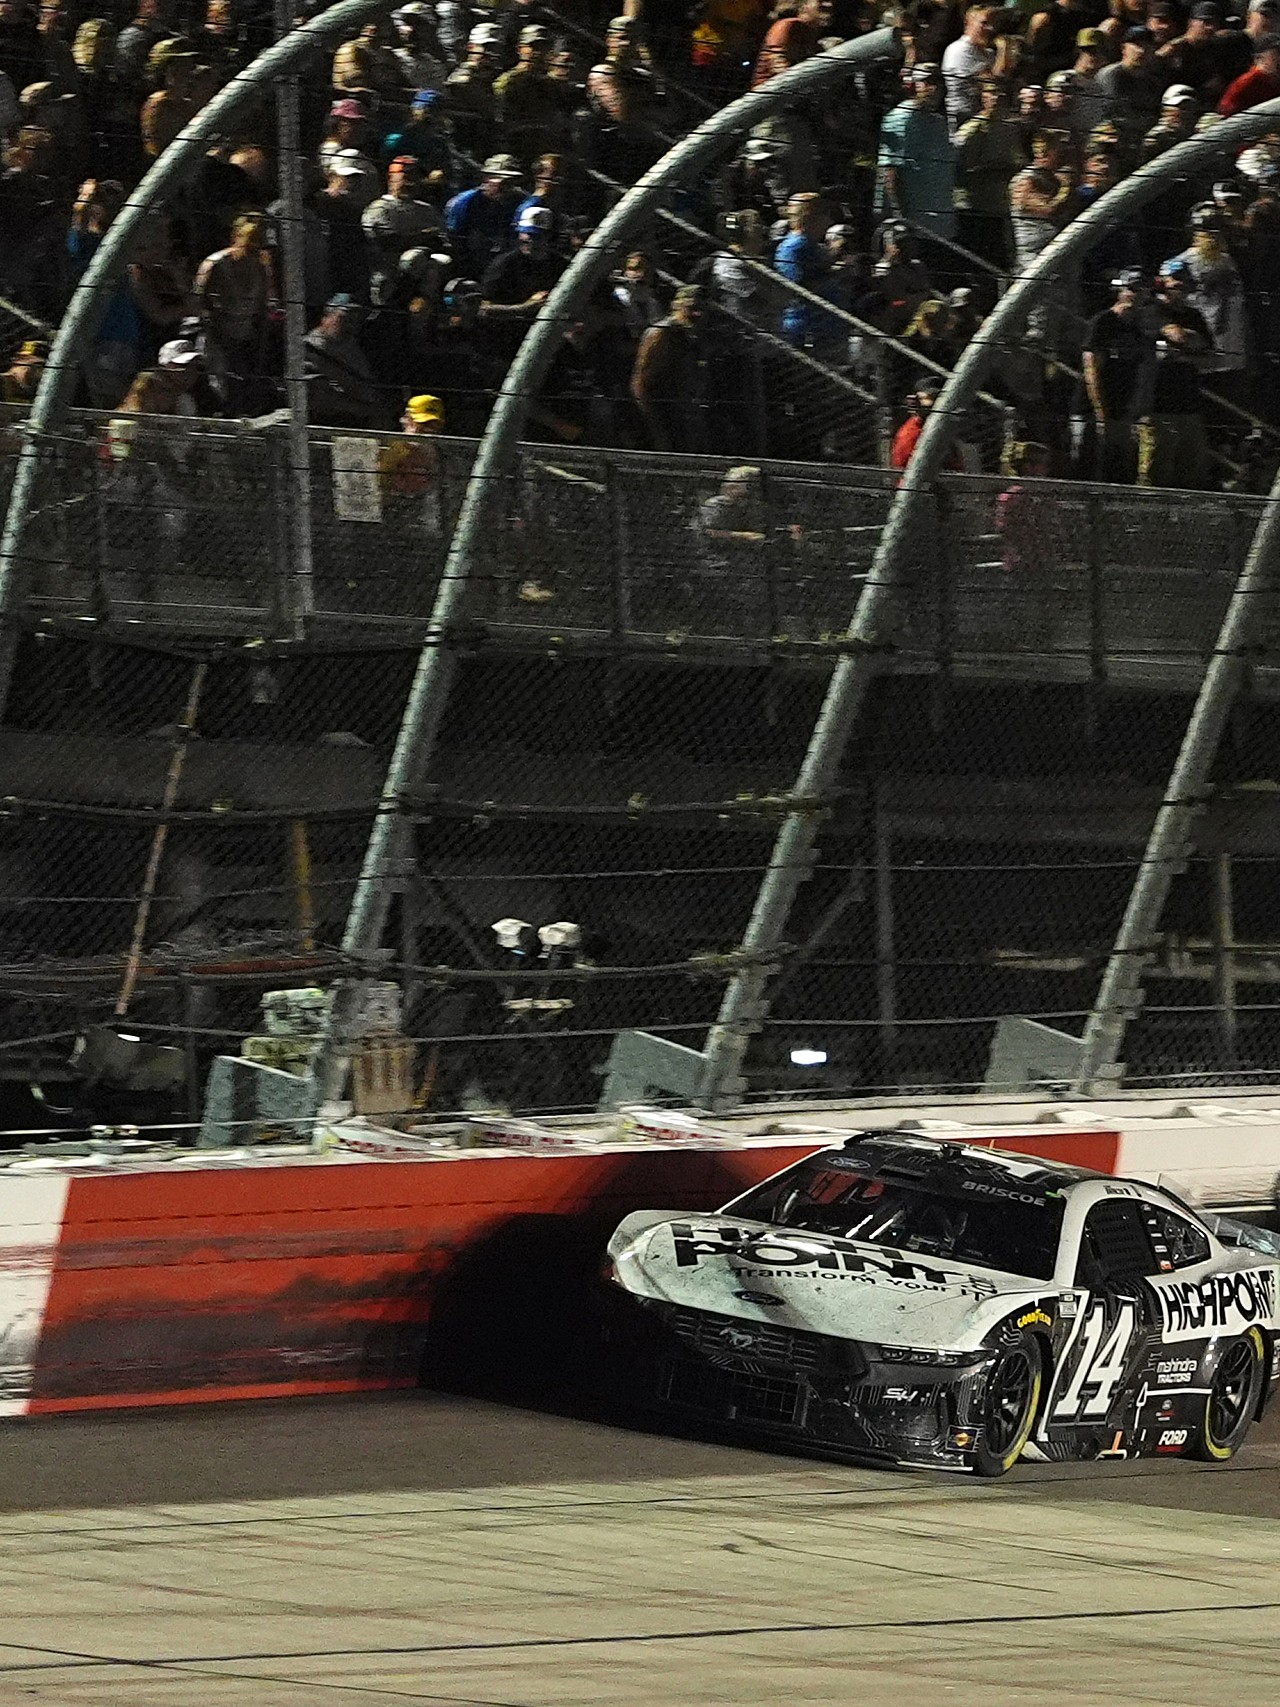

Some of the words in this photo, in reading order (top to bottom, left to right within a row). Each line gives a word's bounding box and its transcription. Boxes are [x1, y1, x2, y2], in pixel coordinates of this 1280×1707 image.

[961, 1181, 1047, 1206] BRISCOE
[732, 1266, 876, 1285] Transform
[886, 1279, 948, 1292] your
[1053, 1305, 1134, 1415] 14
[1156, 1357, 1198, 1374] mahindra
[1158, 1429, 1188, 1446] FORD
